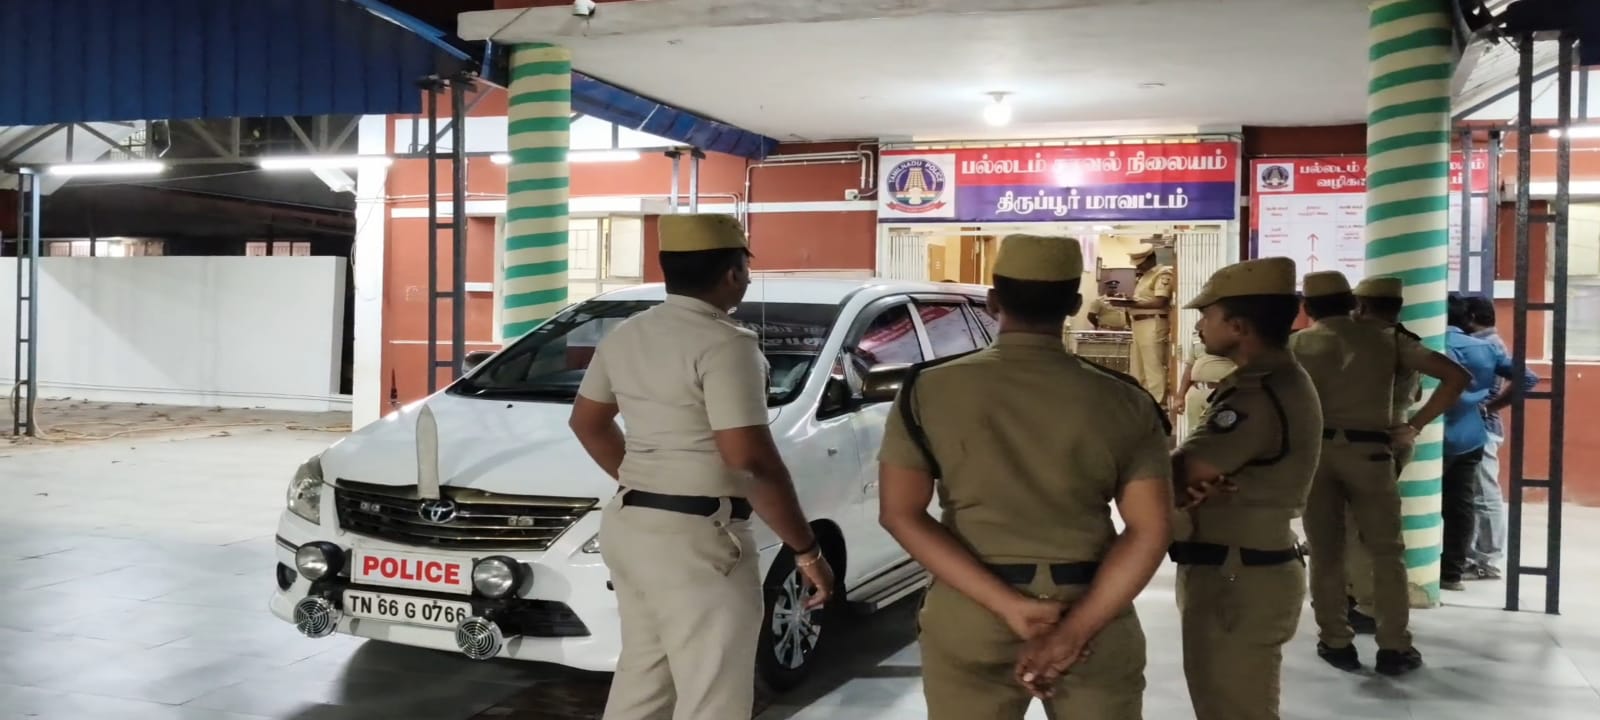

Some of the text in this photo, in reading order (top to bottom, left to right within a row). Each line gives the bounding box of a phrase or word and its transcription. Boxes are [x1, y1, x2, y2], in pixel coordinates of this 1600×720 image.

[961, 153, 1047, 175] பல்லடம்
[1126, 149, 1228, 175] நிலையம்
[995, 187, 1189, 216] திருப்பூர் மாவட்டம்
[363, 555, 460, 585] POLICE
[349, 595, 466, 623] TN 66 G 0766
